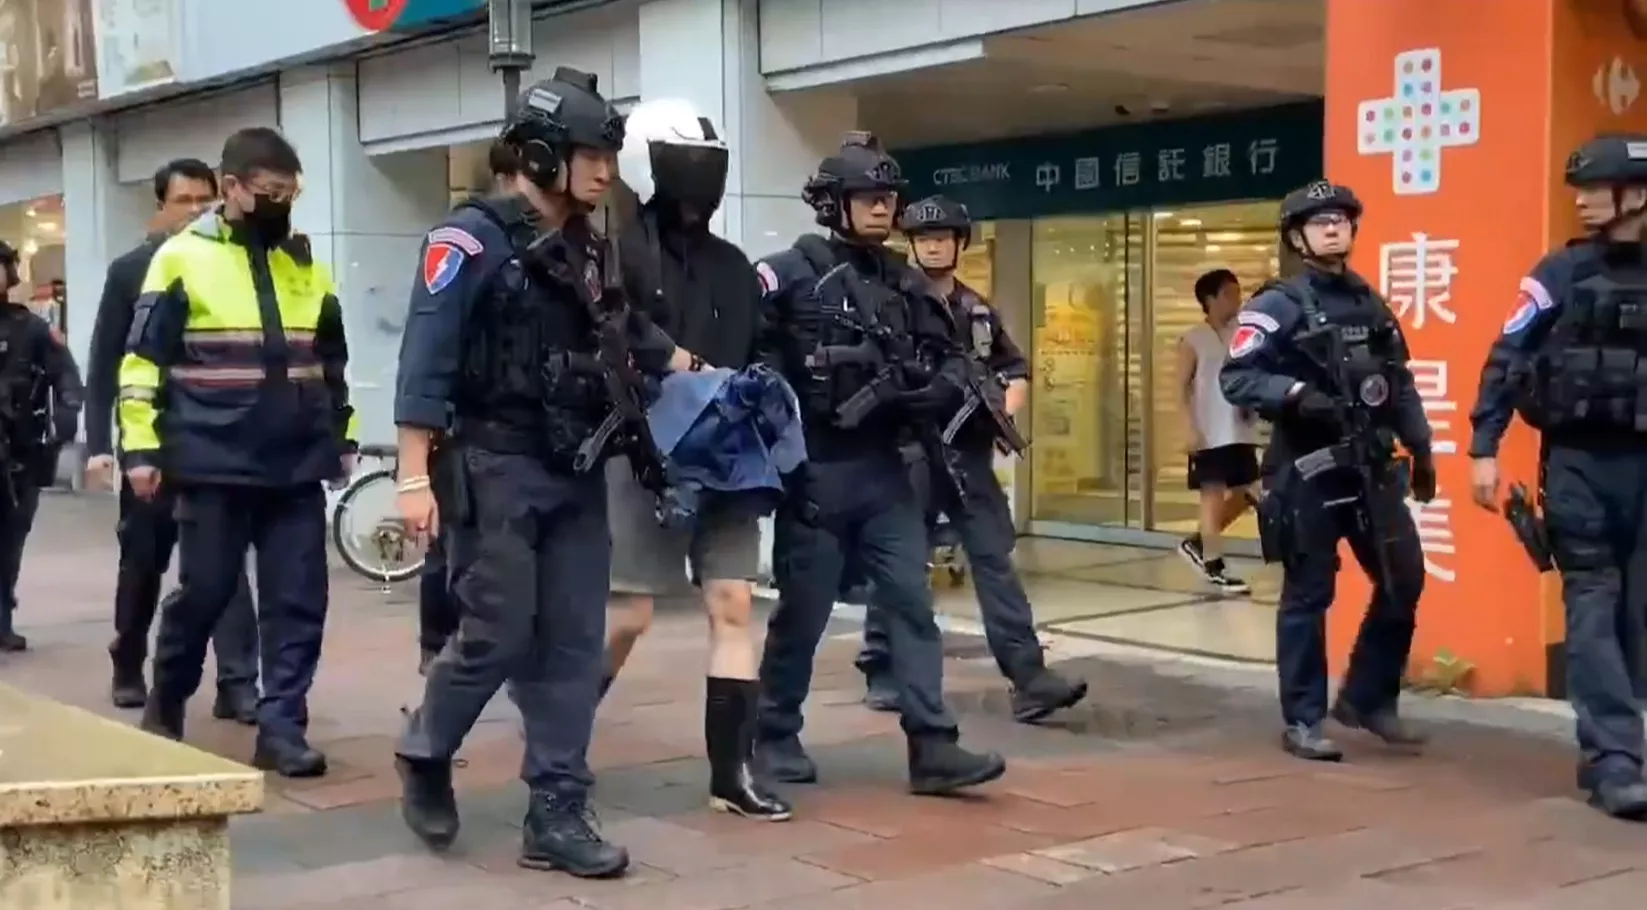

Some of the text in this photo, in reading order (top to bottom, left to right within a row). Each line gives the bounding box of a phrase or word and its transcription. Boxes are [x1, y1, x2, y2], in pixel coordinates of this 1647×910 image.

[1036, 139, 1278, 192] 中國信託銀行
